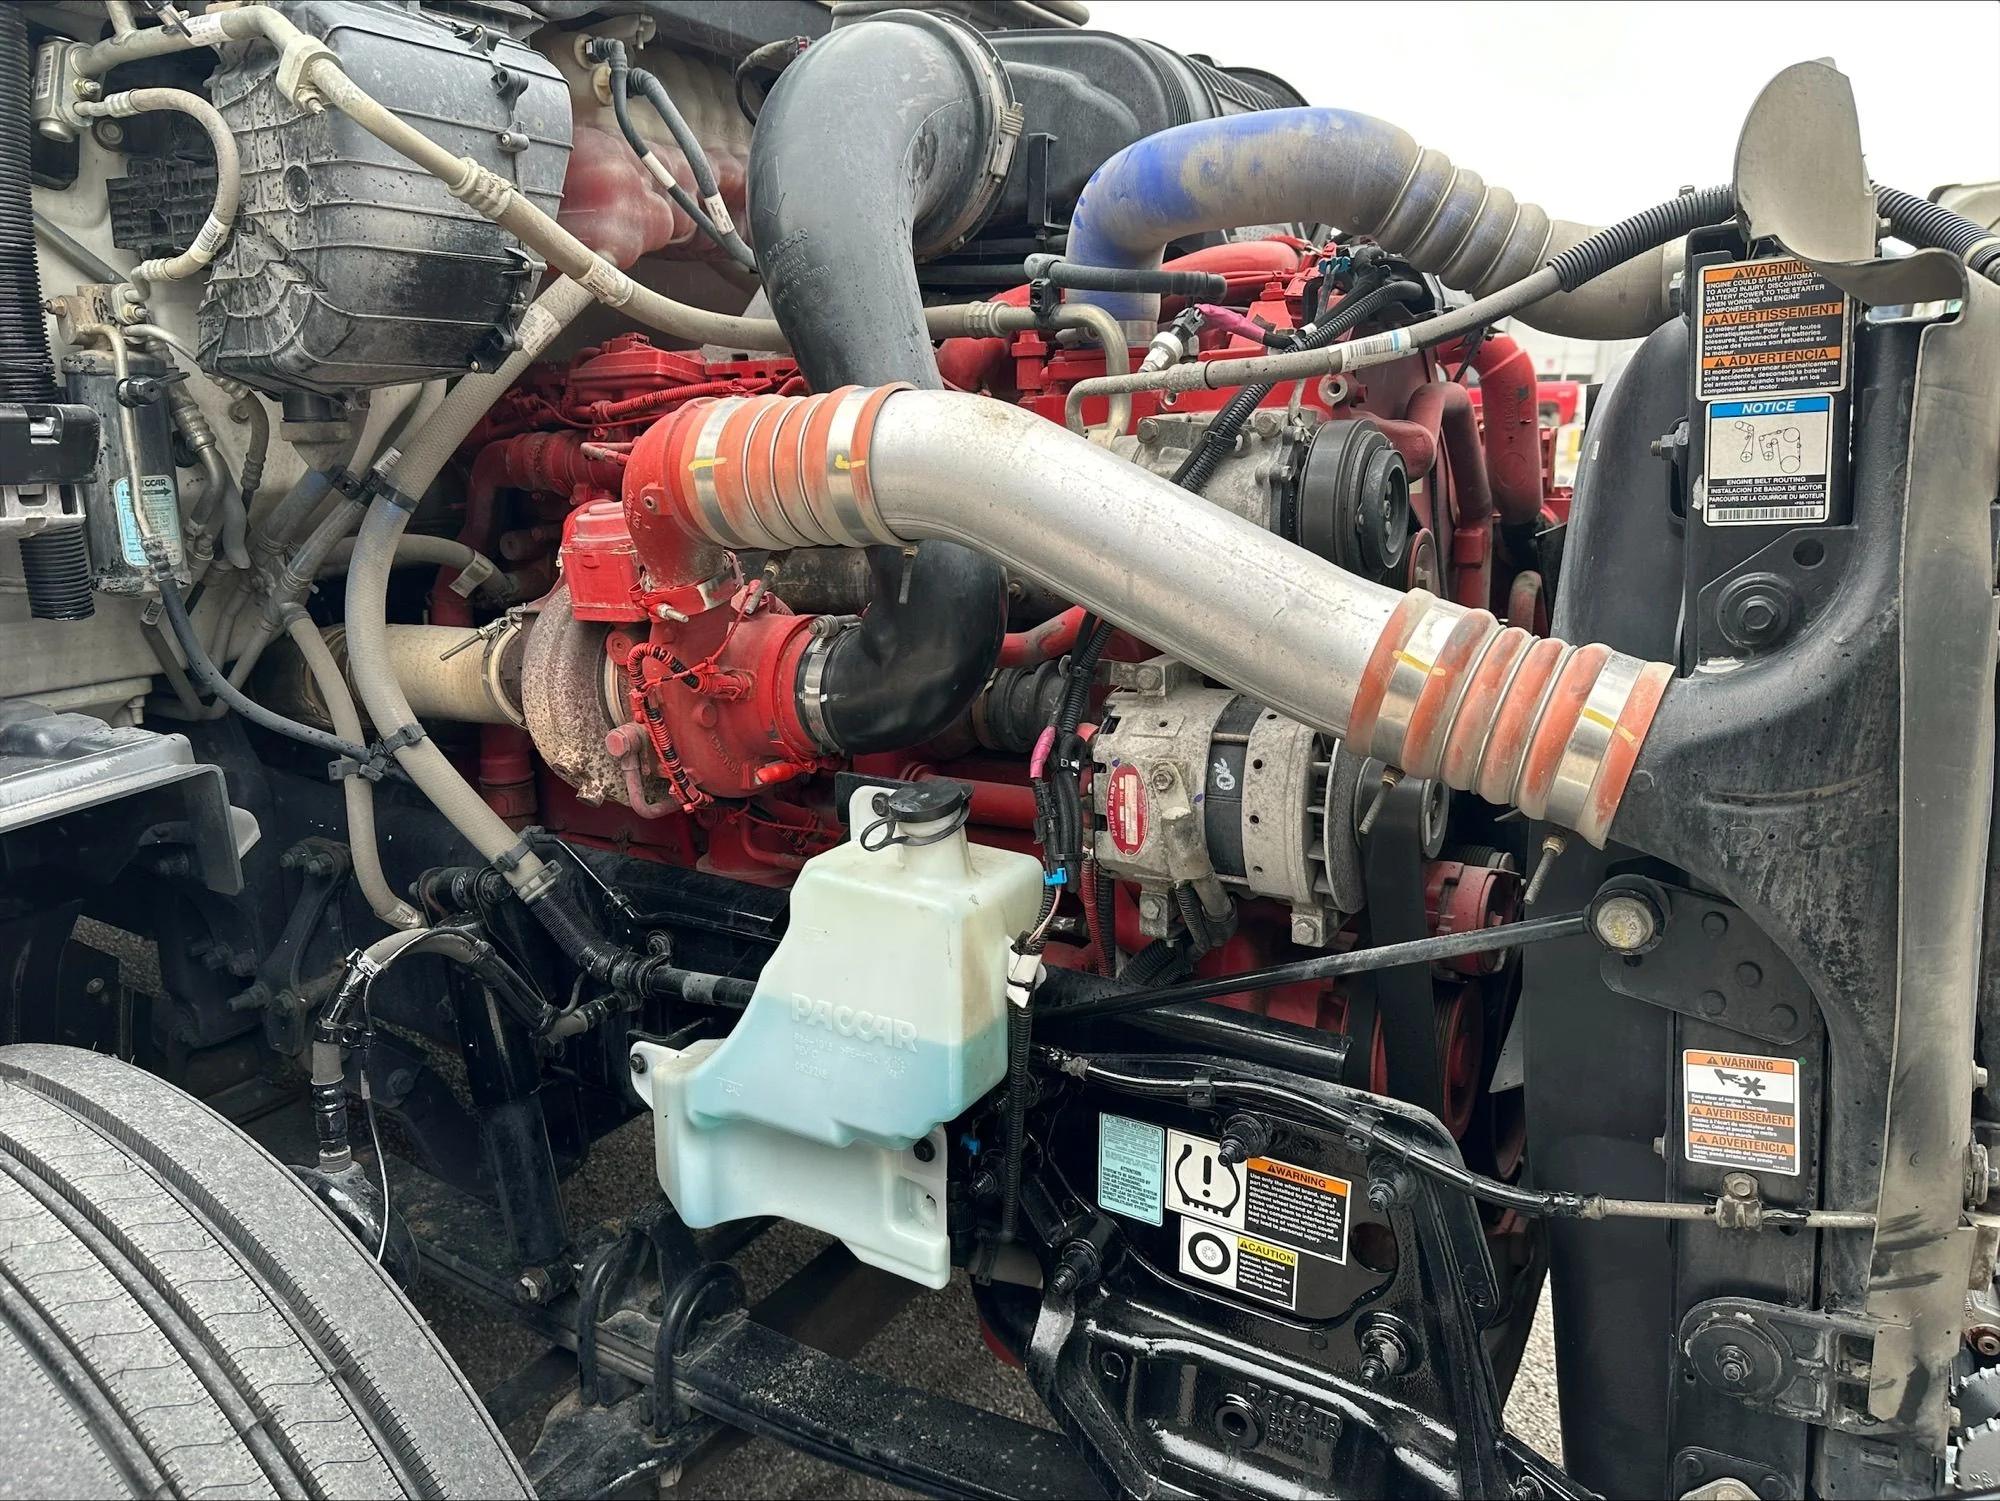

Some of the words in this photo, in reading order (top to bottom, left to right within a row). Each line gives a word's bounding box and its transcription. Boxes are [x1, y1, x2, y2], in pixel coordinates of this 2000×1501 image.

[1706, 281, 1731, 289] ENGINE
[1733, 278, 1756, 286] COULD
[1758, 276, 1781, 284] START
[1767, 279, 1812, 289] DISCONNECT
[1706, 293, 1737, 302] BATTERY
[1739, 290, 1764, 298] POWER
[1792, 284, 1825, 293] STARTER
[1728, 297, 1760, 305] WORKING
[1774, 293, 1800, 301] ENGINE
[1706, 304, 1754, 314] COMPONENTS.
[1721, 304, 1837, 324] AVERTISSEMENT
[1739, 334, 1779, 342] Déconnecter
[1729, 349, 1828, 365] ADVERTENCIA
[1732, 367, 1752, 375] puede
[1776, 375, 1798, 383] trabaje
[1704, 386, 1746, 394] componentes
[1742, 401, 1796, 414] NOTICE
[1108, 780, 1116, 807] Remy
[791, 992, 919, 1053] PACCAR
[1721, 1057, 1773, 1070] WARNING
[1706, 1108, 1791, 1125] AVERTISSEMENT
[1712, 1136, 1787, 1153] ADVERTENCIA
[1275, 1167, 1326, 1188] WARNING
[1250, 1186, 1277, 1198] equipment
[1284, 1184, 1300, 1192] wheel
[1271, 1186, 1294, 1196] installed
[1313, 1199, 1335, 1208] original
[1249, 1192, 1271, 1202] different
[1273, 1199, 1288, 1207] wheel
[1290, 1204, 1305, 1212] brand
[1326, 1216, 1341, 1224] could
[1249, 1198, 1265, 1206] cause
[1303, 1214, 1325, 1225] interfere
[1253, 1205, 1268, 1213] brake
[1269, 1211, 1299, 1223] component
[1300, 1220, 1317, 1228] which
[1318, 1226, 1334, 1234] could
[1279, 1227, 1303, 1237] personal
[1287, 1223, 1306, 1231] vehicle
[1307, 1229, 1326, 1238] control
[1249, 1243, 1293, 1263] CAUTION
[1239, 1271, 1255, 1279] proper
[1256, 1276, 1272, 1285] torque
[1265, 1274, 1282, 1282] manual
[1246, 1381, 1343, 1438] PACCAR
